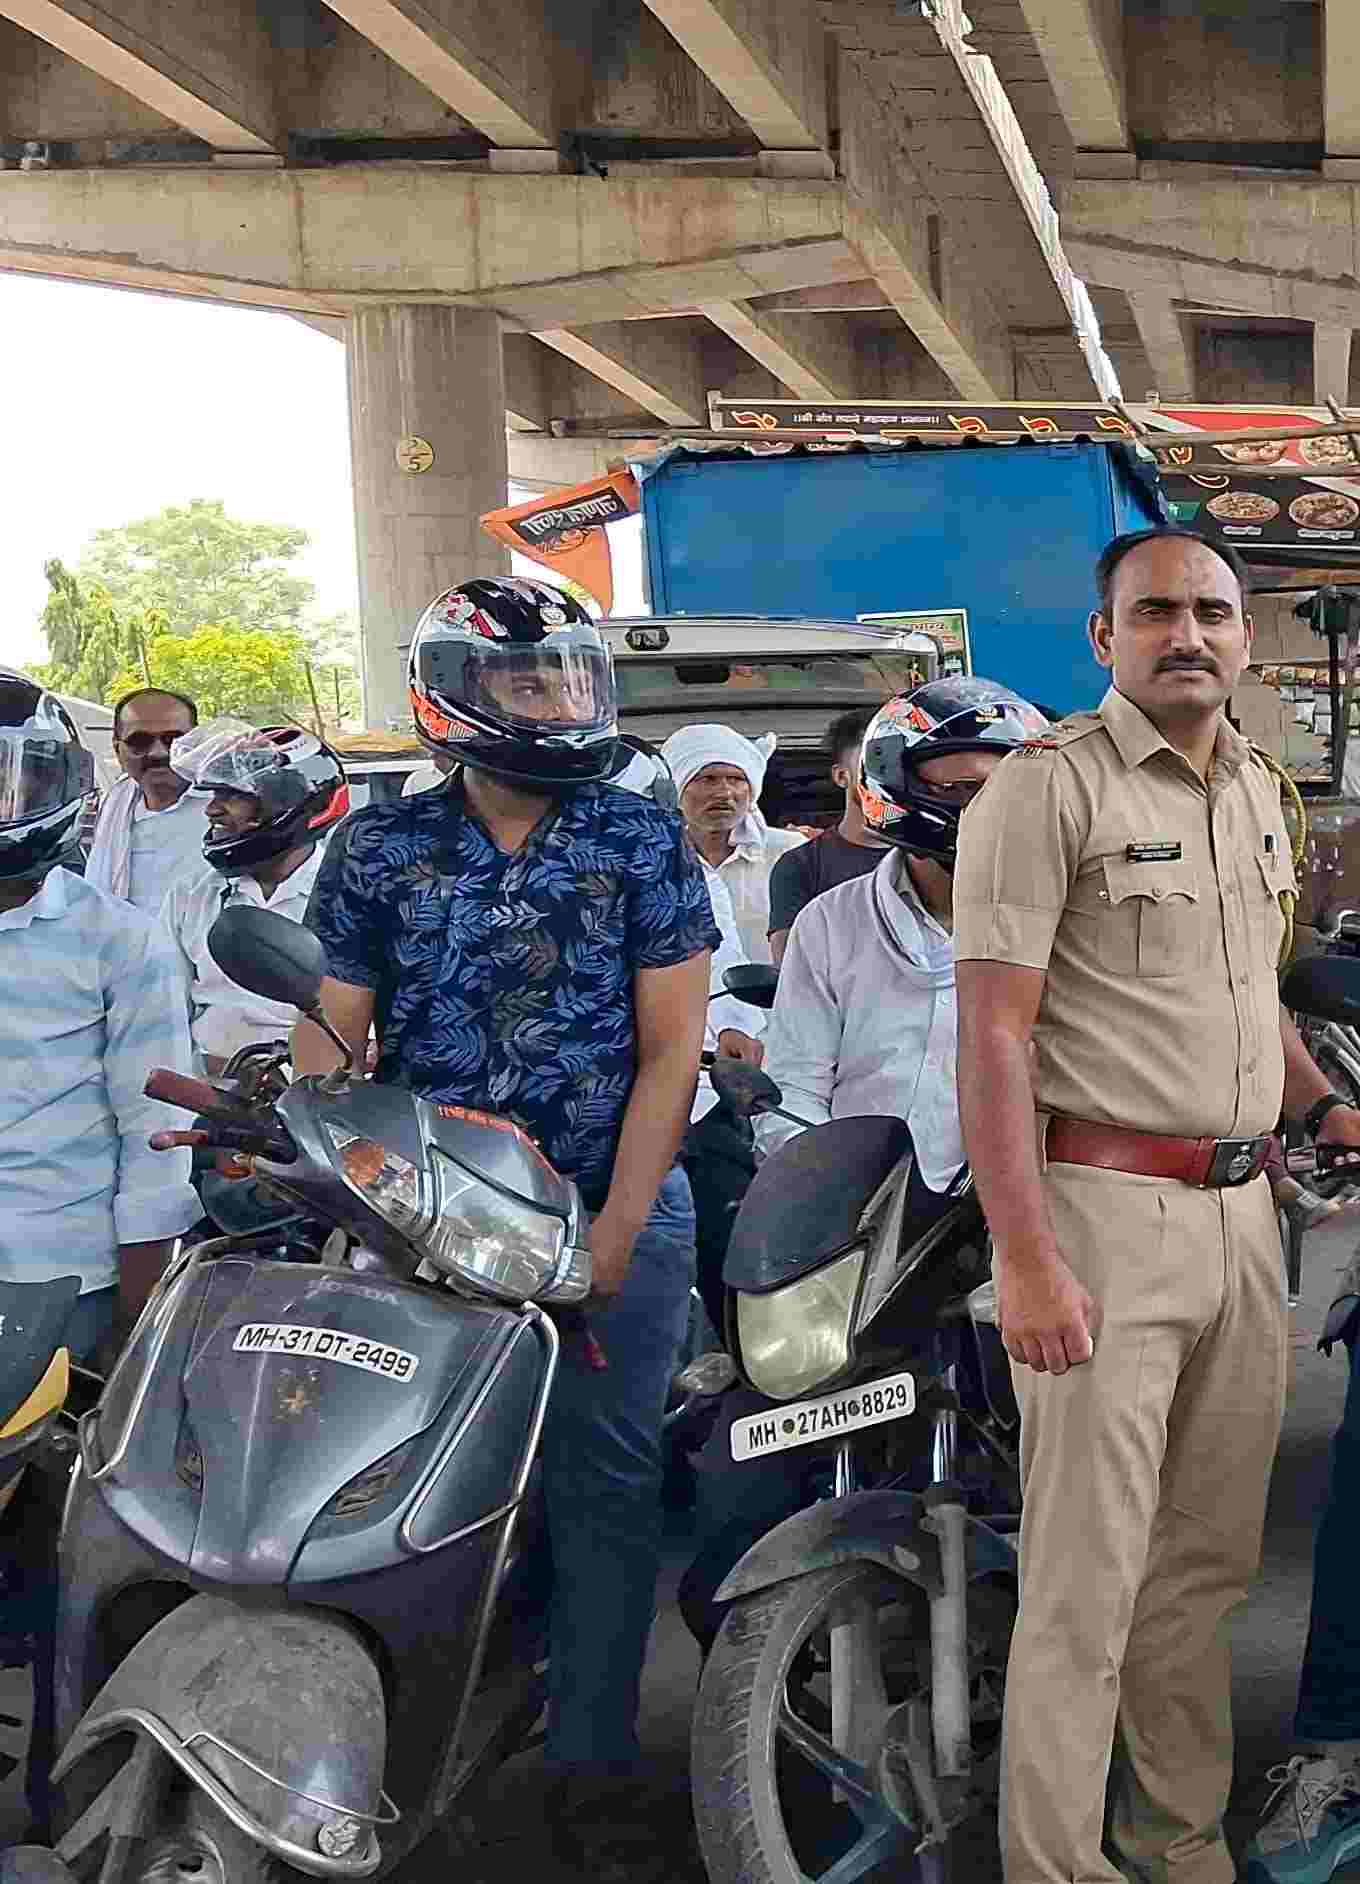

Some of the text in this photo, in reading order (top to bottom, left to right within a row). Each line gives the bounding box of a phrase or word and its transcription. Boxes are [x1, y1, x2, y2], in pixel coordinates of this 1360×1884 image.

[748, 1384, 907, 1449] MH 27AH 8829
